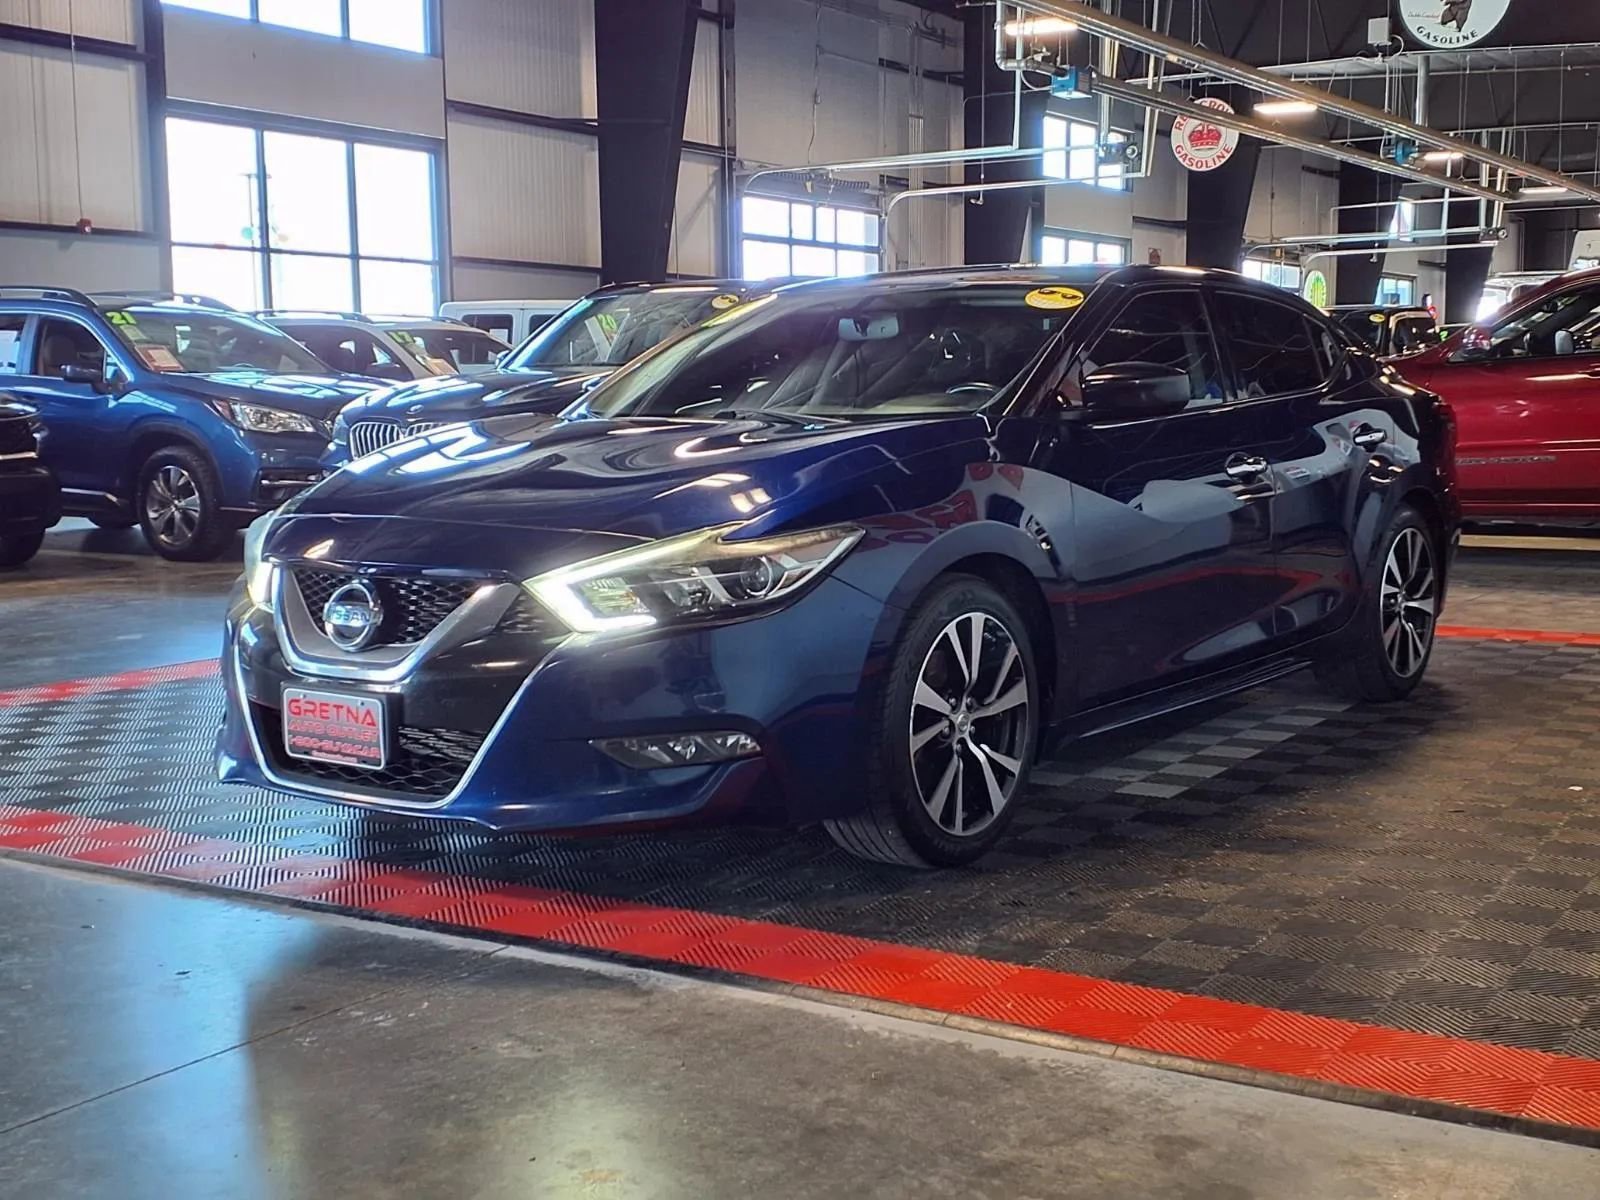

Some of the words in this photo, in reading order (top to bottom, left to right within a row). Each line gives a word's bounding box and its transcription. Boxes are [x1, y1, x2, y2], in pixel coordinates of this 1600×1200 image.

[1416, 25, 1478, 44] GASOLINE
[1175, 144, 1233, 169] GASOLINE
[105, 311, 137, 325] 21
[327, 608, 371, 623] SSAN
[288, 698, 377, 727] GRETNA
